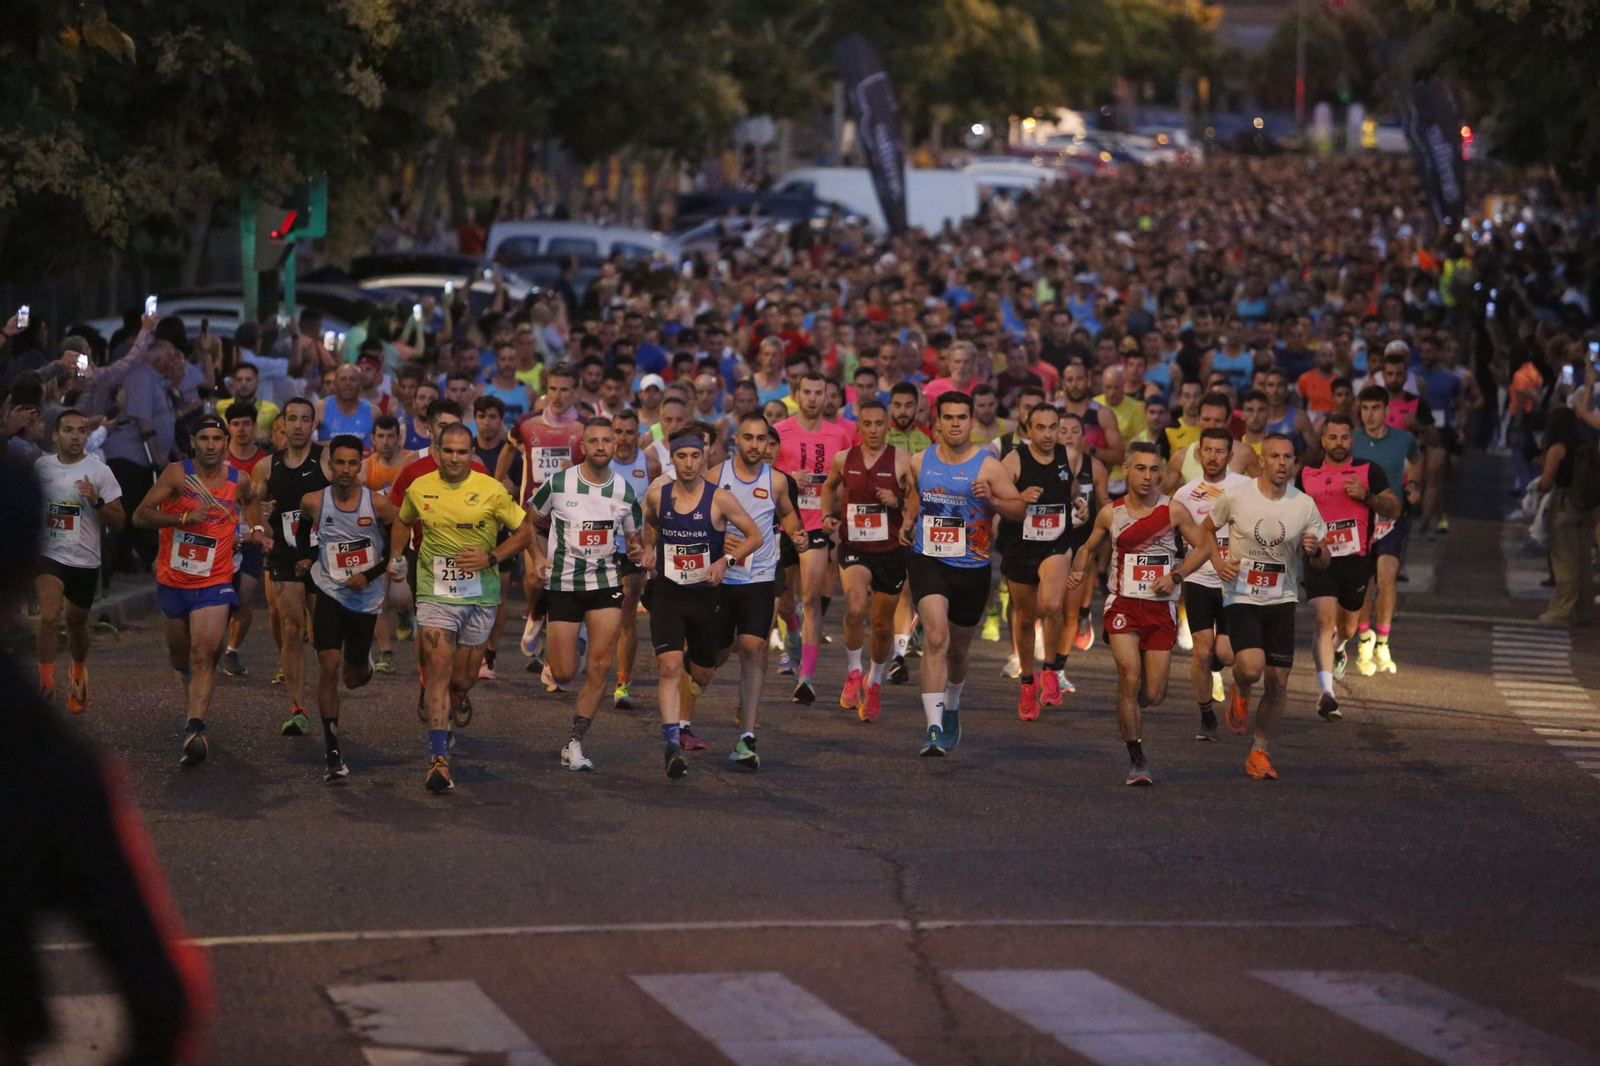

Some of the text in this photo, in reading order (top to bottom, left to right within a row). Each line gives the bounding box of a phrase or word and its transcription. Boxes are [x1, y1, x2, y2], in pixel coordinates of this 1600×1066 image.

[538, 458, 563, 468] 210
[805, 487, 817, 496] 95
[923, 492, 931, 502] 20
[931, 497, 968, 506] TROTACALLES
[51, 506, 59, 514] 21
[858, 506, 867, 515] 21
[53, 518, 66, 529] 74
[584, 522, 593, 530] 21
[864, 518, 871, 528] 6
[935, 519, 943, 527] 21
[1039, 518, 1052, 528] 46
[1328, 523, 1337, 531] 21
[662, 528, 707, 538] TROTASIERRA
[933, 532, 954, 542] 272
[1332, 533, 1345, 543] 14
[185, 535, 195, 544] 21
[587, 535, 600, 545] 59
[341, 543, 350, 553] 21
[678, 547, 686, 556] 21
[935, 544, 942, 552] H
[188, 549, 196, 559] 5
[181, 560, 188, 568] H
[345, 556, 360, 566] 69
[682, 560, 696, 570] 20
[1139, 557, 1148, 565] 21
[1255, 563, 1265, 572] 21
[345, 569, 353, 577] H
[442, 569, 474, 581] 2135
[1141, 570, 1156, 580] 28
[1255, 576, 1270, 586] 33
[1251, 587, 1259, 595] H
